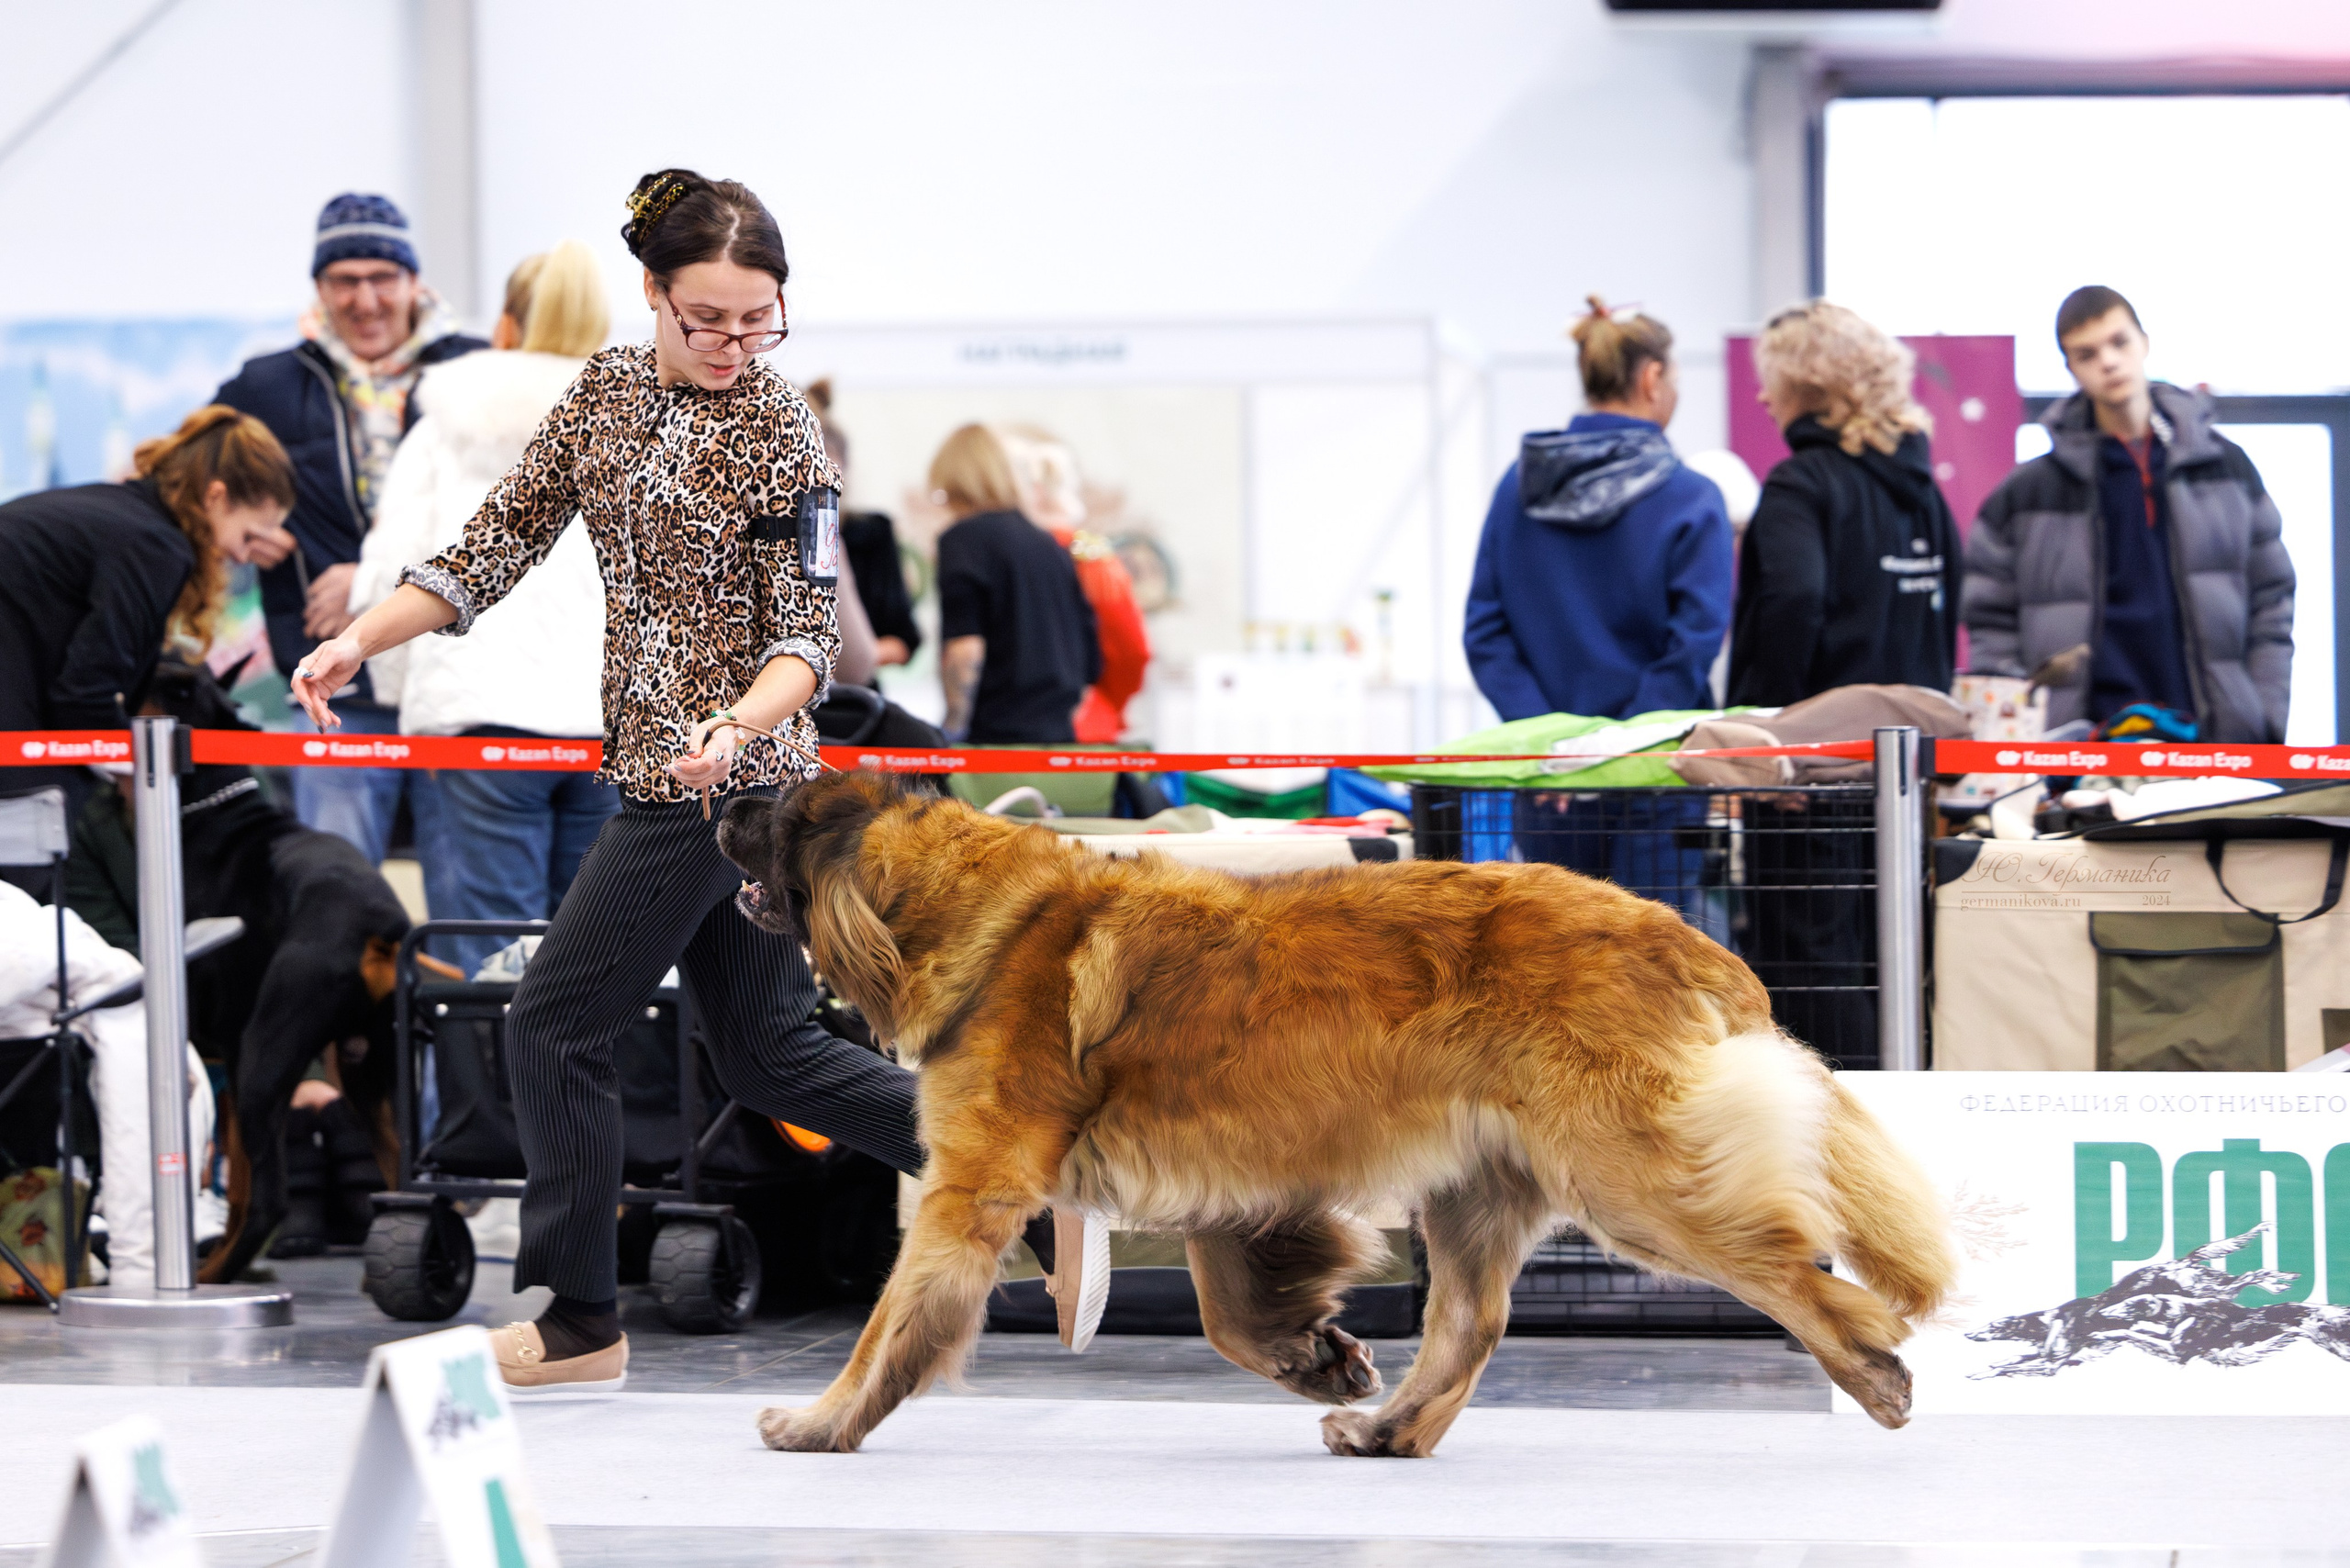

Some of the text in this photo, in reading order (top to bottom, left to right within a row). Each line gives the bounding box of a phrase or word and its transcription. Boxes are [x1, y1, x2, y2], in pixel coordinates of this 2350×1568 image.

[48, 739, 129, 759] Kazan Expo
[329, 741, 410, 760] Kazan Expo
[508, 745, 588, 763] Kazan Expo
[885, 755, 966, 768] Kazan Expo
[1075, 756, 1157, 767] Kazan Expo
[2022, 750, 2108, 770] Kazan Expo
[2167, 751, 2252, 771] Kazan Expo
[1959, 1094, 2348, 1114] ФЕДЕРАЦИЯ ОХОТНИЧЬЕГО
[2074, 1137, 2350, 1308] РФ
